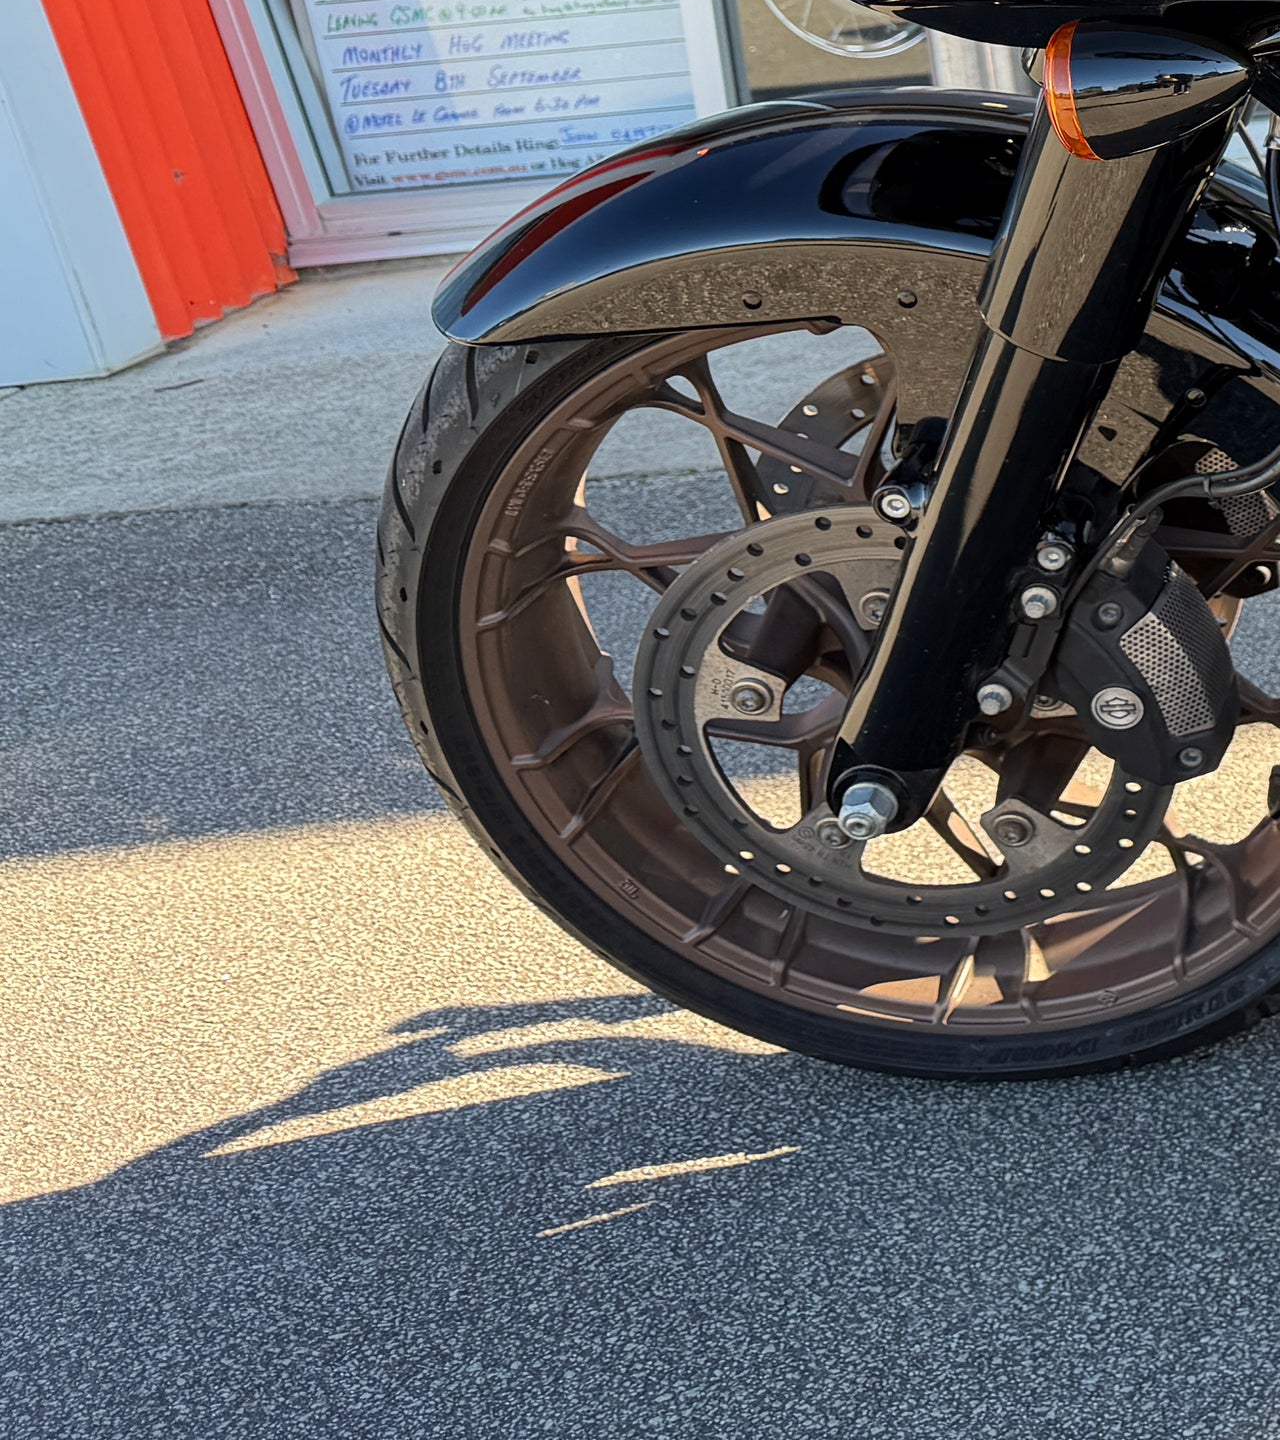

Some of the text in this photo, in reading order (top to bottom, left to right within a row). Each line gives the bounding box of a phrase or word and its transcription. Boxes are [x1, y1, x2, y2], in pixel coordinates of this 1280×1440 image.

[342, 43, 423, 66] MONTHLY
[501, 29, 570, 51] MEETING
[339, 73, 412, 103] TUESDAY
[354, 152, 380, 167] For
[385, 147, 449, 165] Further
[454, 140, 512, 158] Details
[354, 174, 387, 187] Visit
